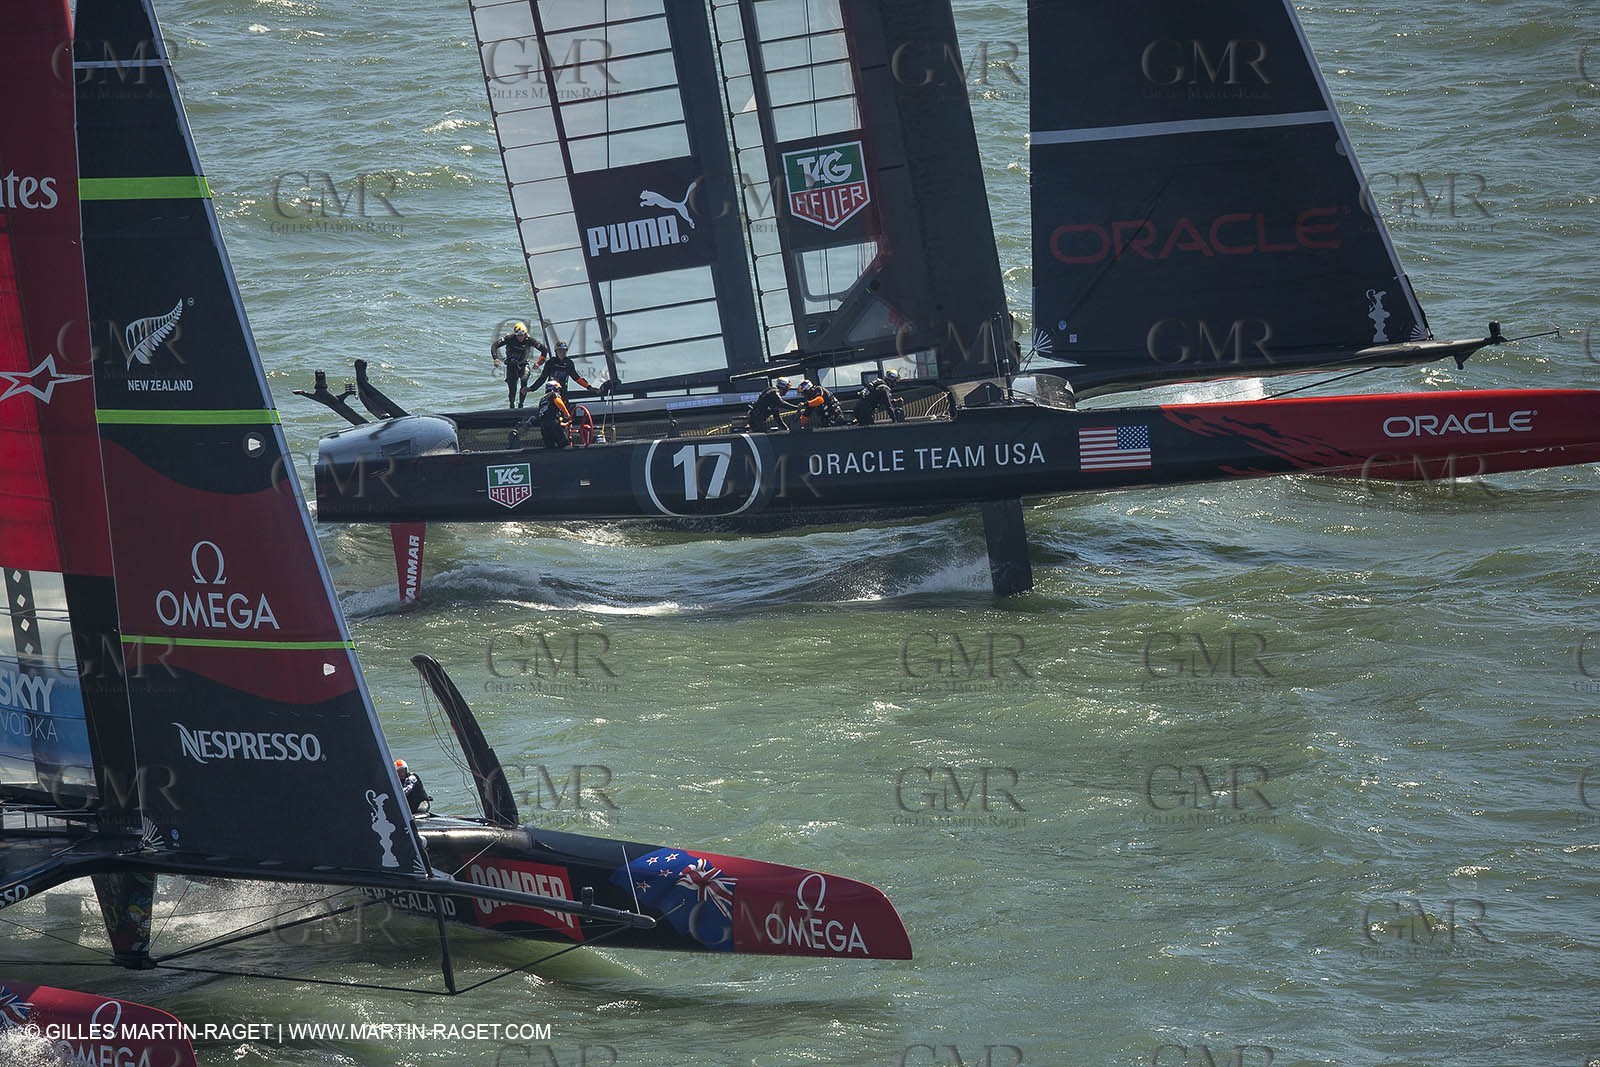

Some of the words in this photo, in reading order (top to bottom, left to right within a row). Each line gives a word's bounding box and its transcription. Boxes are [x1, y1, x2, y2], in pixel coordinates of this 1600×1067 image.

[797, 150, 852, 187] TAG
[795, 186, 864, 223] HEUER
[586, 215, 680, 257] PUMA
[1050, 208, 1342, 264] ORACLE
[128, 380, 149, 391] NEW
[150, 380, 193, 391] ZEALAND
[1383, 410, 1533, 437] ORACLE
[494, 466, 524, 485] TAG
[673, 443, 732, 501] 17
[809, 449, 905, 476] ORACLE
[914, 445, 986, 469] TEAM
[994, 442, 1046, 465] USA
[491, 486, 529, 505] HEUER
[155, 589, 280, 630] OMEGA
[0, 670, 56, 713] SKYY
[0, 711, 59, 742] VODKA
[171, 722, 321, 764] NESPRESSO
[765, 913, 869, 954] OMEGA
